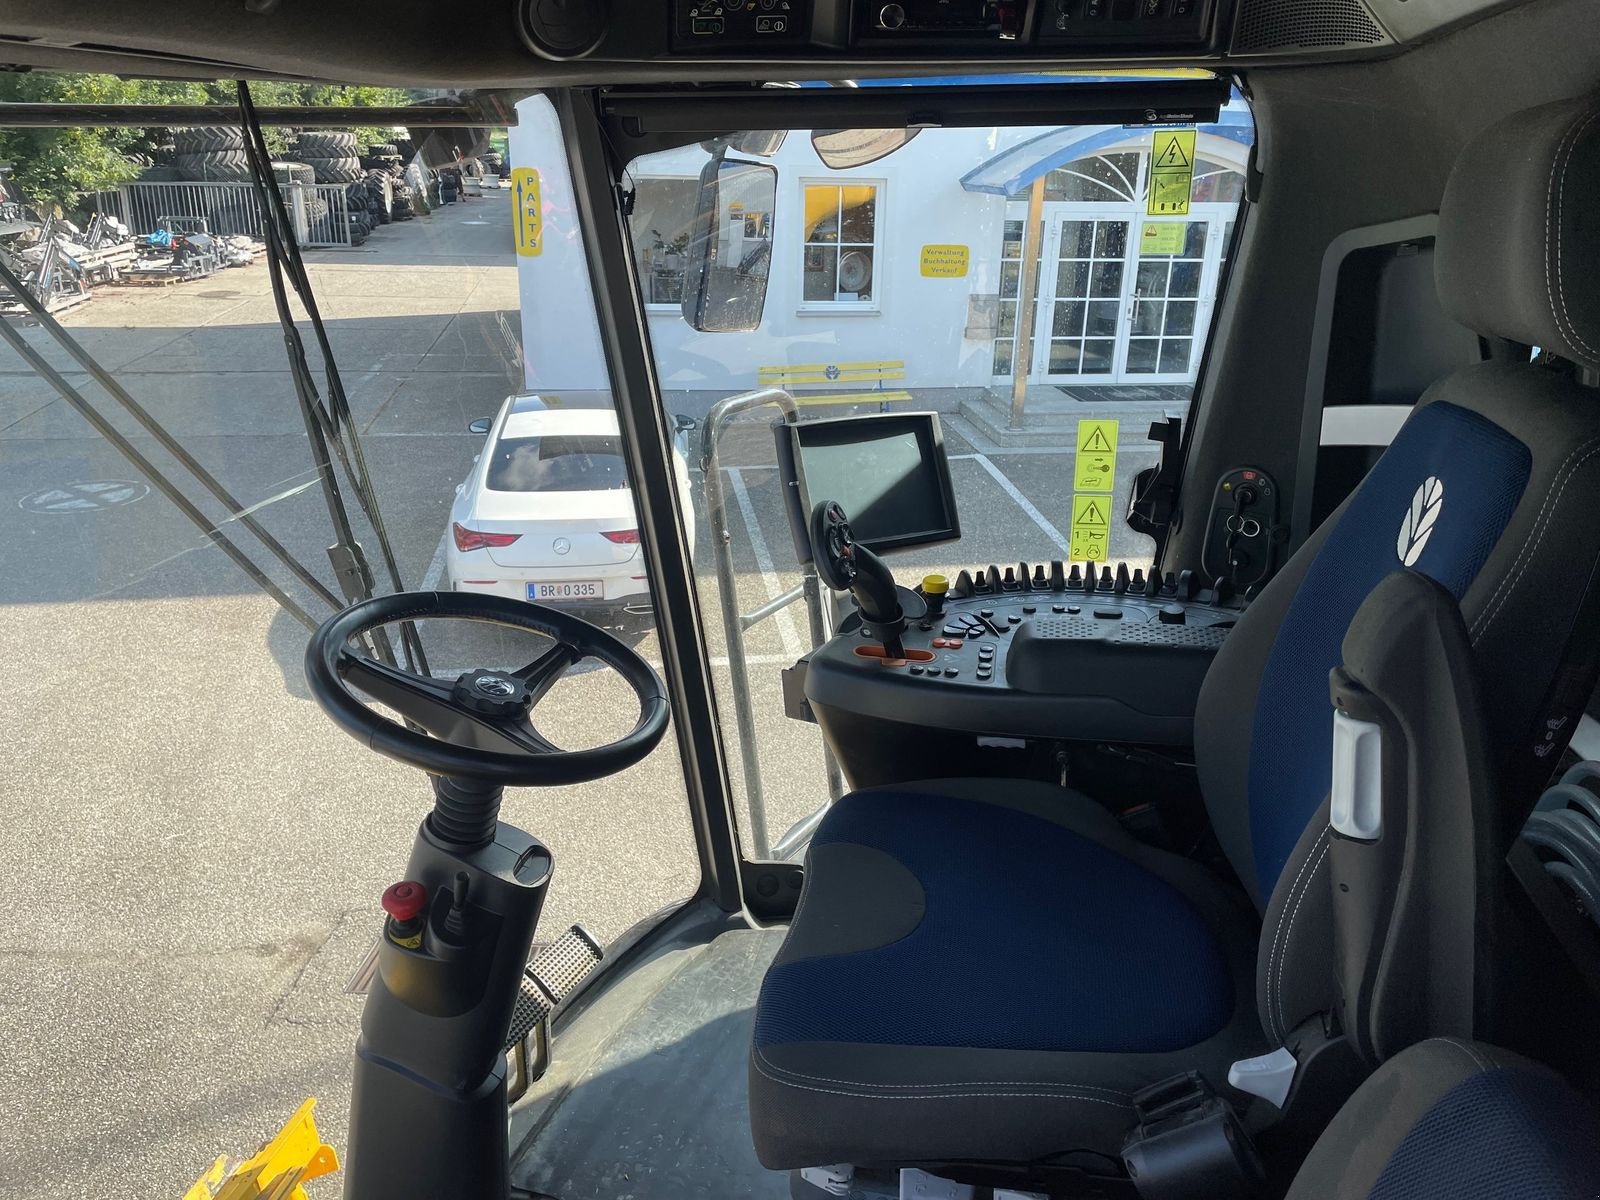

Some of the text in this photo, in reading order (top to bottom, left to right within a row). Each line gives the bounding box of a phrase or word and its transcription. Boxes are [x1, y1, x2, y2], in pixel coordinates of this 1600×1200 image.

[527, 177, 537, 248] PARTS
[1075, 531, 1079, 539] 1
[1073, 547, 1080, 556] 2
[540, 585, 555, 597] BR
[573, 584, 595, 596] 335
